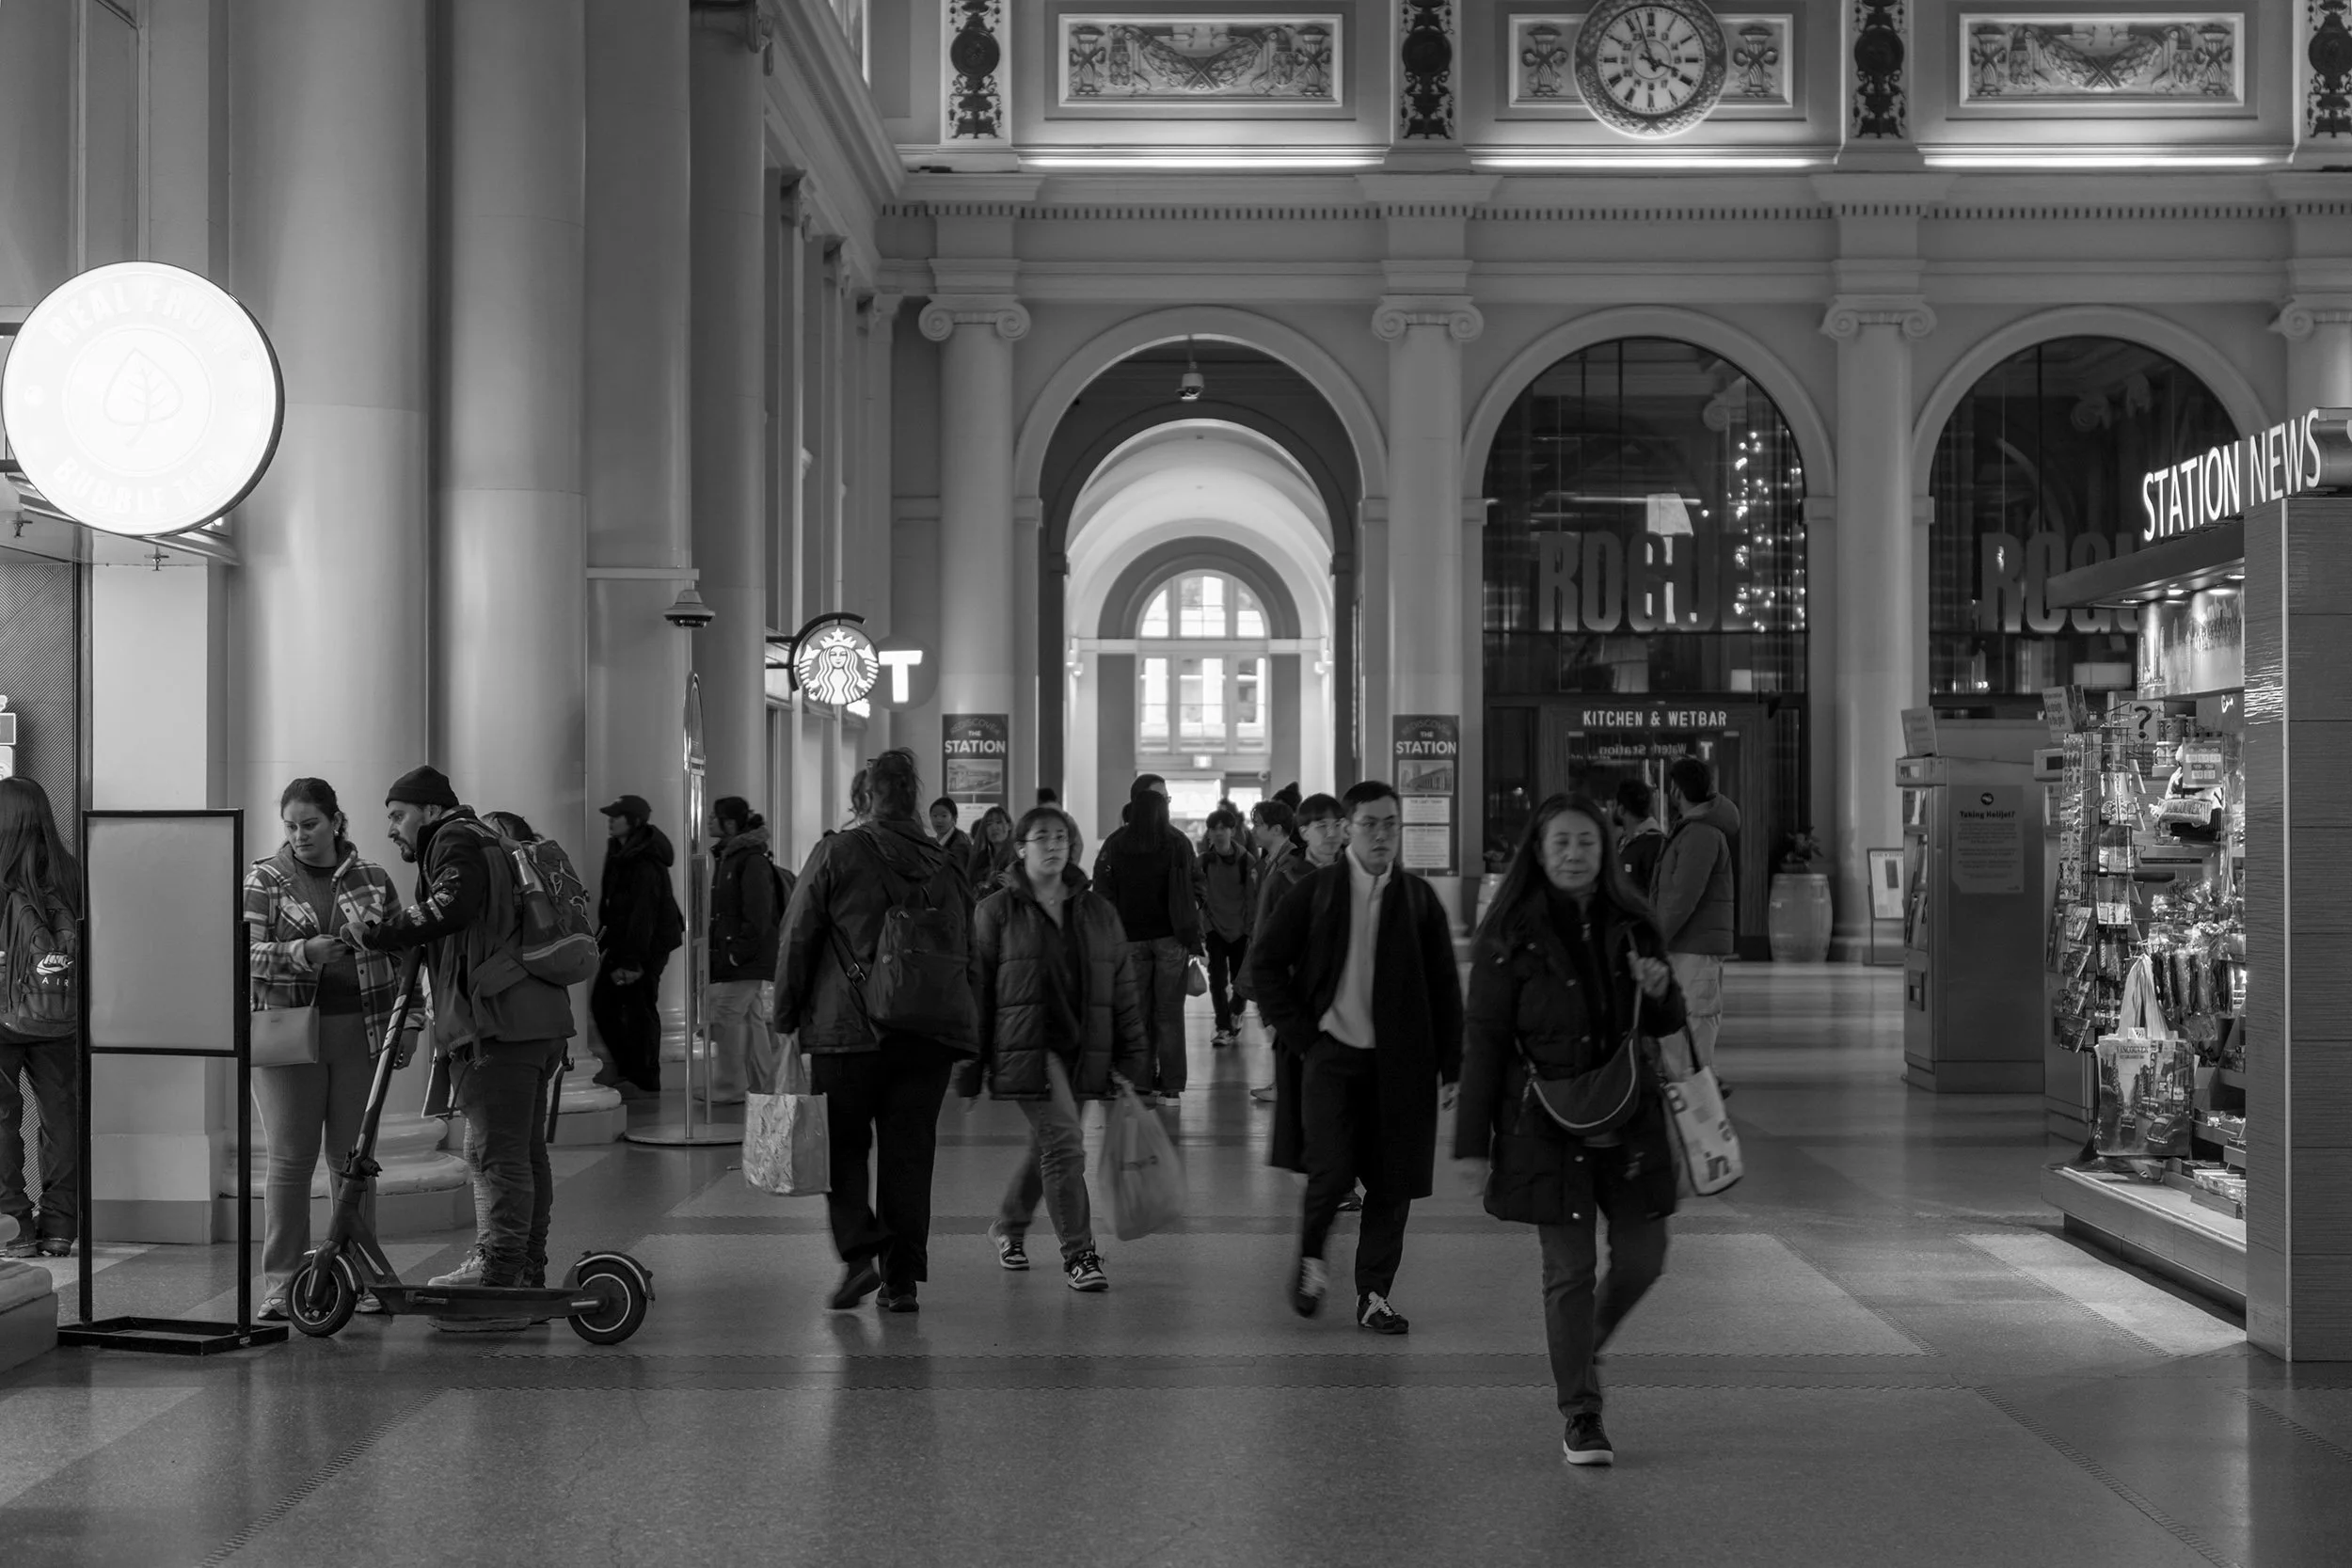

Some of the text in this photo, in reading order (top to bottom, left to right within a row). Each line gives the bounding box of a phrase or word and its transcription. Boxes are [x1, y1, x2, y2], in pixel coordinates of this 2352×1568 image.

[44, 279, 242, 356] REAL FRUIT
[53, 455, 226, 515] BUBBLE TEA
[2143, 408, 2322, 542] STATION NEWS
[1538, 530, 1756, 633] ROGUE
[879, 650, 923, 704] T
[1582, 710, 1728, 727] KITCHEN & WETBAR
[945, 739, 1006, 753] STATION
[1395, 740, 1457, 755] STATION
[1959, 810, 1984, 820] Taking
[41, 976, 69, 987] AIR
